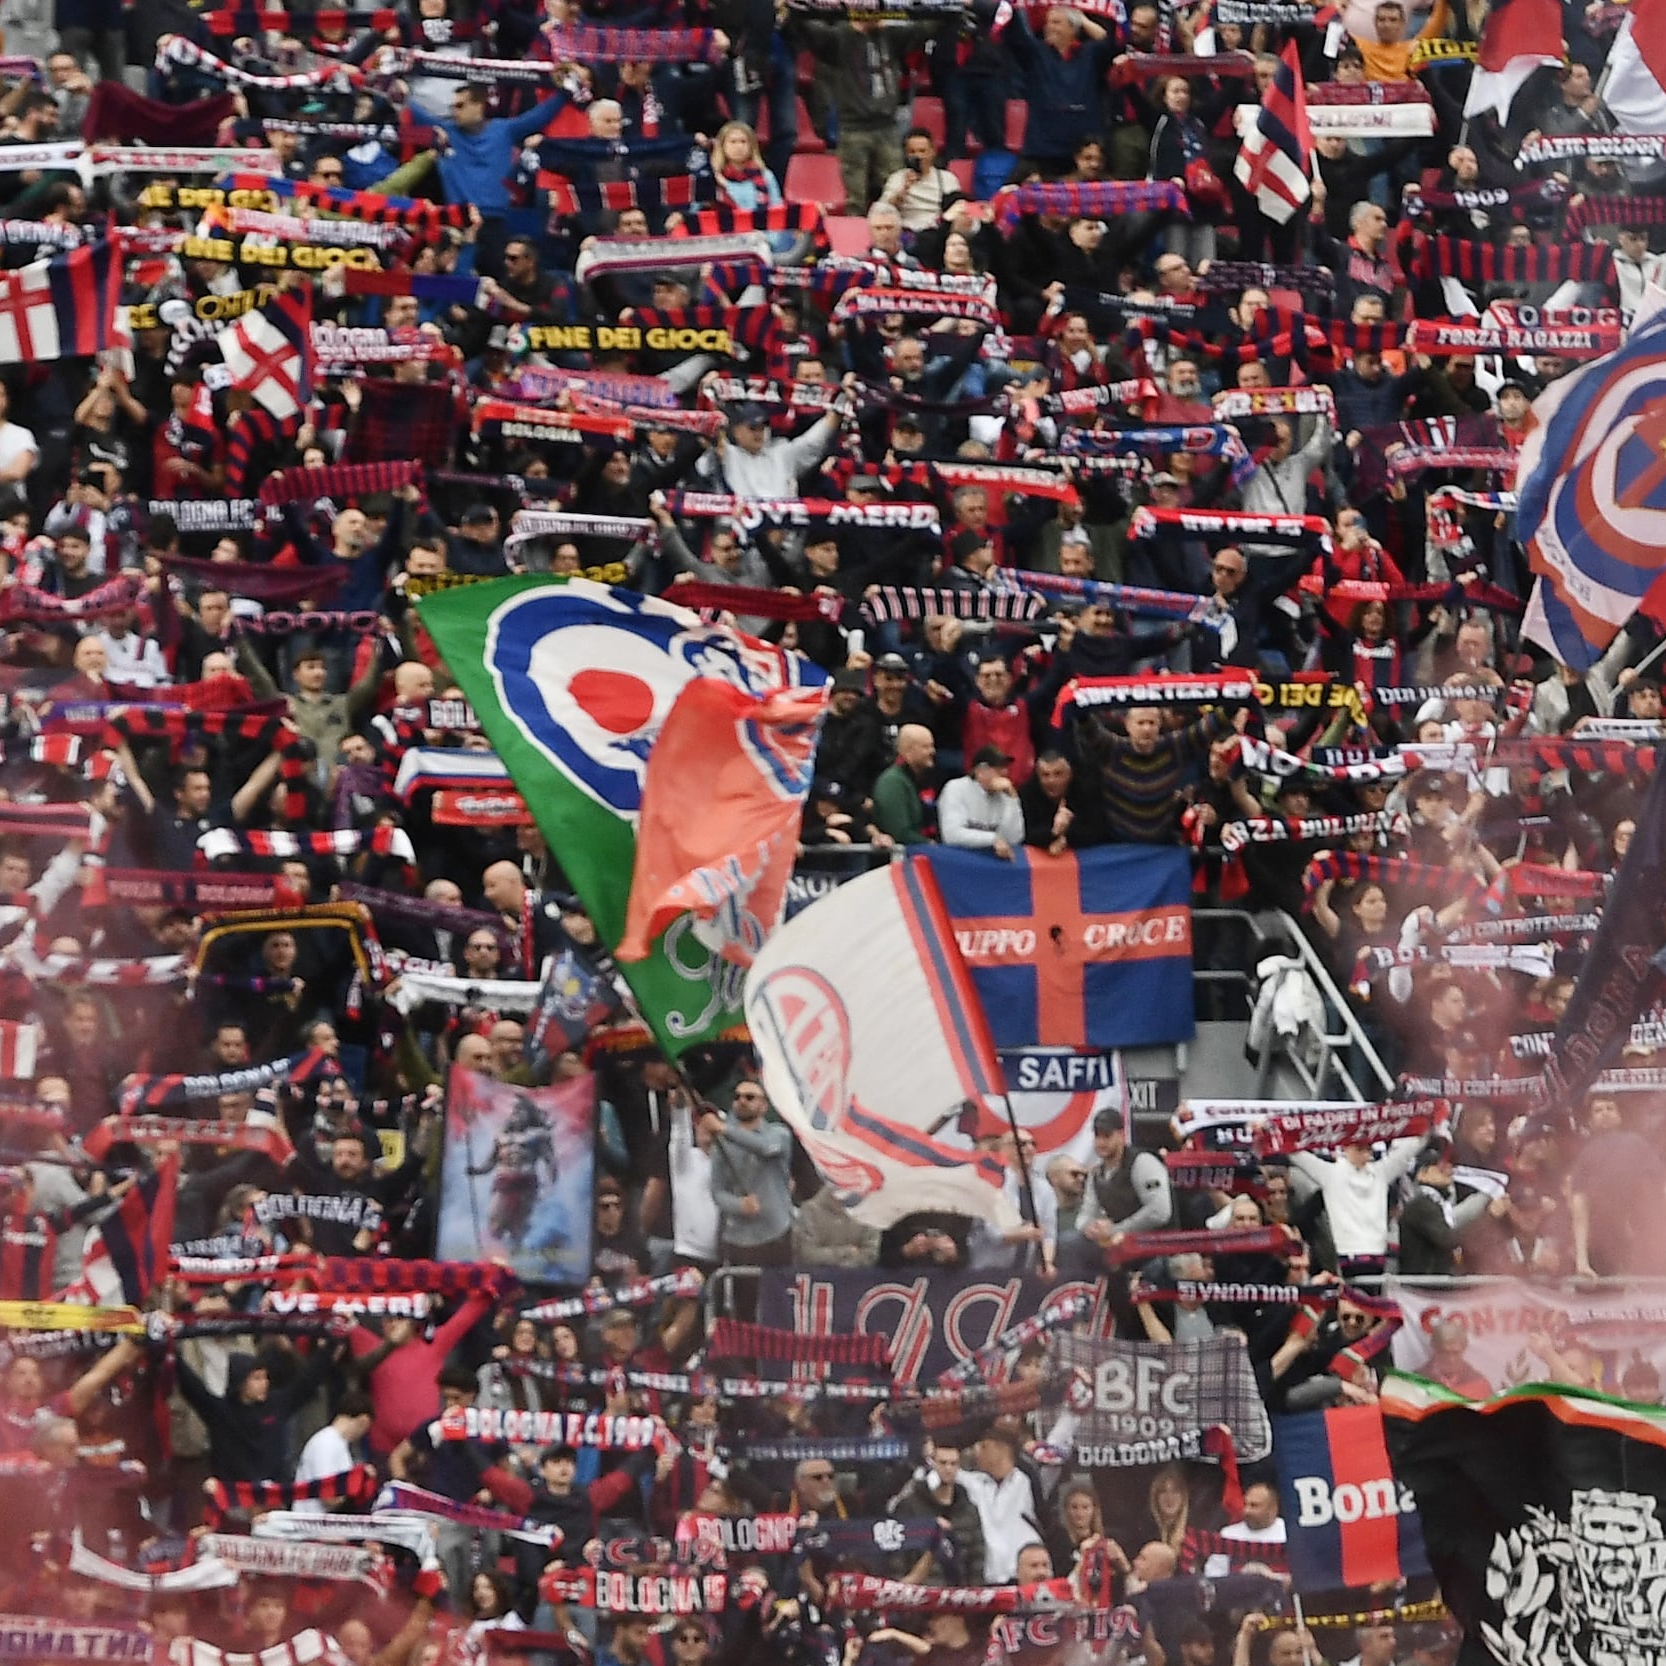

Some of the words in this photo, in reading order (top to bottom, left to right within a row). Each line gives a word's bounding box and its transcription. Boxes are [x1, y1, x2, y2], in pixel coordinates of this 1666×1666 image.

[1453, 187, 1510, 208] 1909
[530, 325, 591, 350] FINE
[598, 325, 641, 351] DEI
[1436, 328, 1500, 348] FORZA
[1506, 327, 1592, 349] RAGAZZI
[1083, 912, 1187, 948] CROCE
[1129, 1079, 1159, 1109] XIT
[1093, 1356, 1193, 1416] BFC
[1107, 1413, 1175, 1438] 1909
[595, 1570, 701, 1615] BOLOGNA
